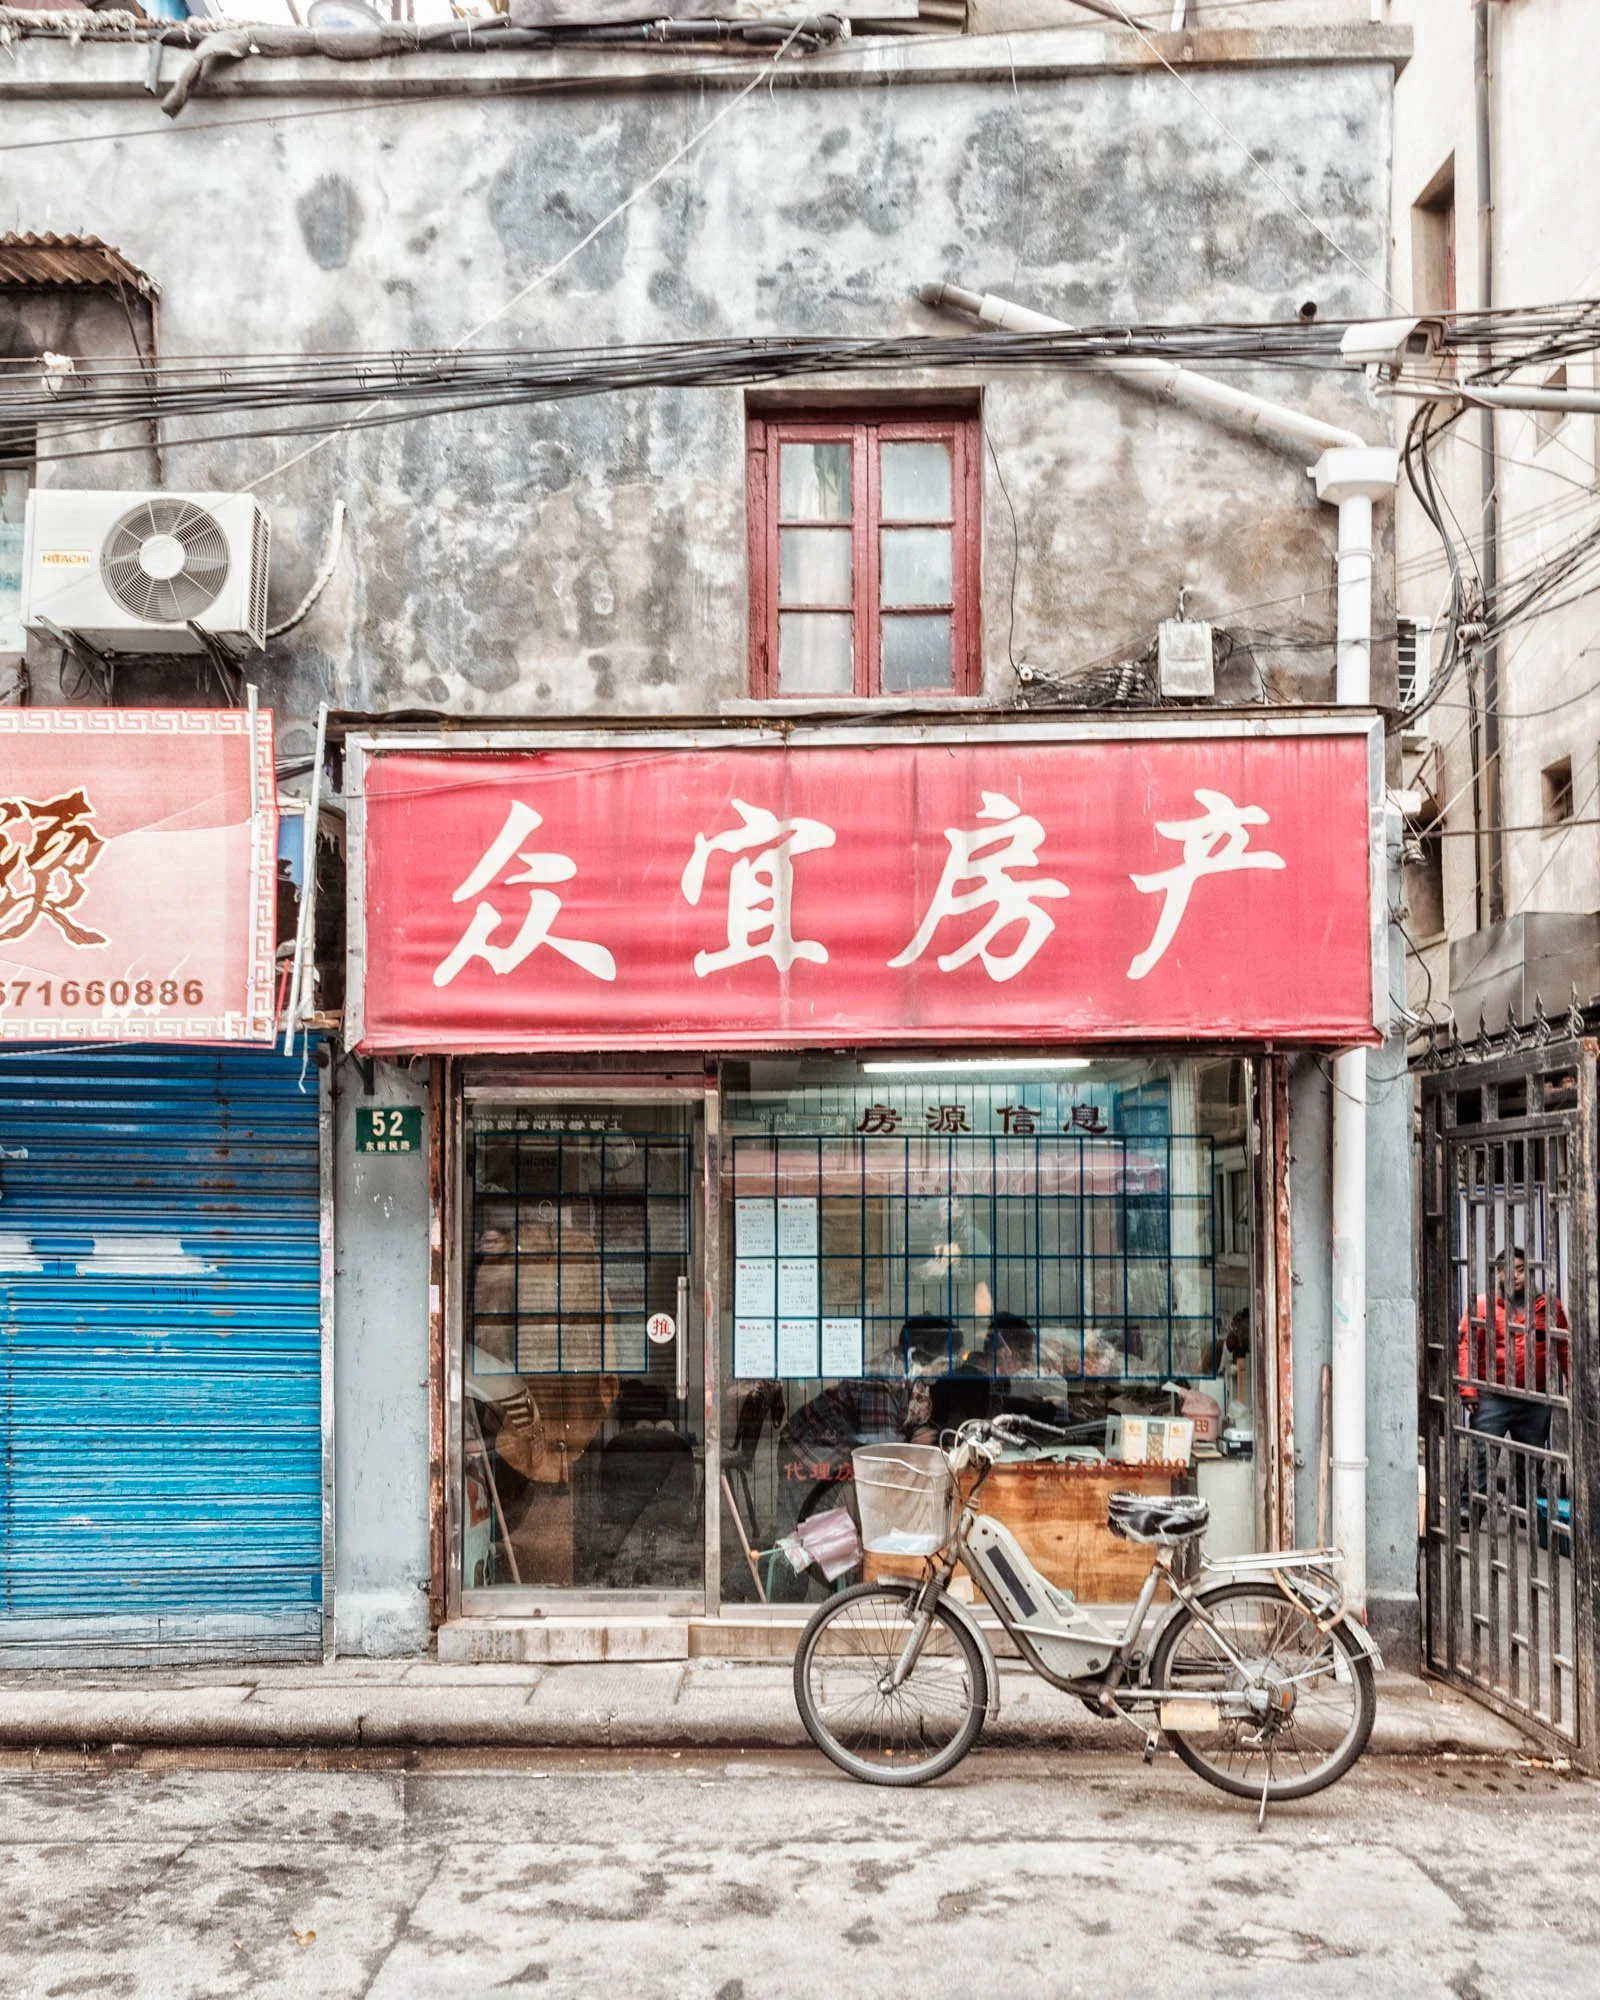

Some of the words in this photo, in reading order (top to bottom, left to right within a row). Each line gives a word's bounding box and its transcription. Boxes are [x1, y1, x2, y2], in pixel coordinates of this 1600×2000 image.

[42, 554, 89, 564] HITACHI
[432, 790, 1286, 988] 众宜房产
[372, 1111, 403, 1137] 52
[856, 1104, 1109, 1135] 房源信息
[652, 1317, 672, 1336] 推
